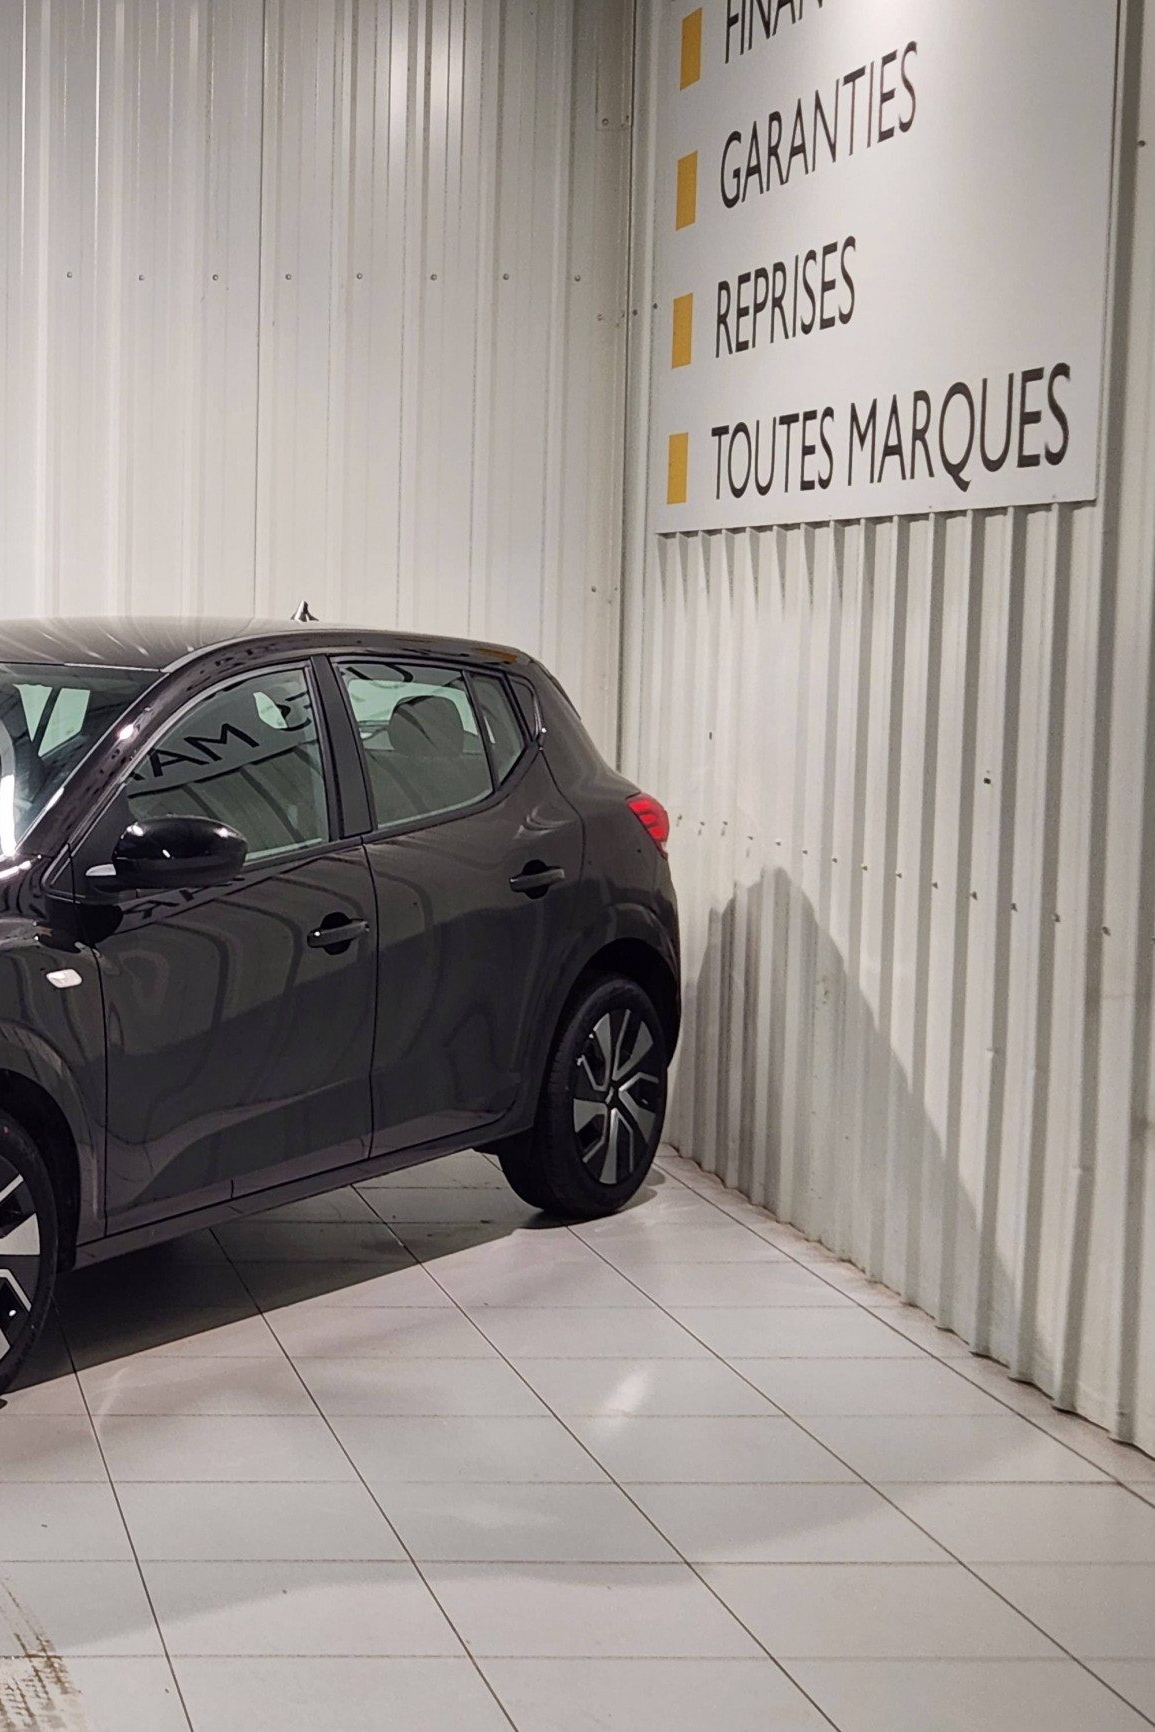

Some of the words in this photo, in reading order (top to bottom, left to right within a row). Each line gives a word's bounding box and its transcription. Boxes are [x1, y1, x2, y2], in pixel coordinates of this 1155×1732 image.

[720, 41, 918, 209] GARANTIES
[715, 235, 856, 359] REPRISES
[711, 406, 835, 500] TOUTES
[847, 362, 1071, 493] MARQUES
